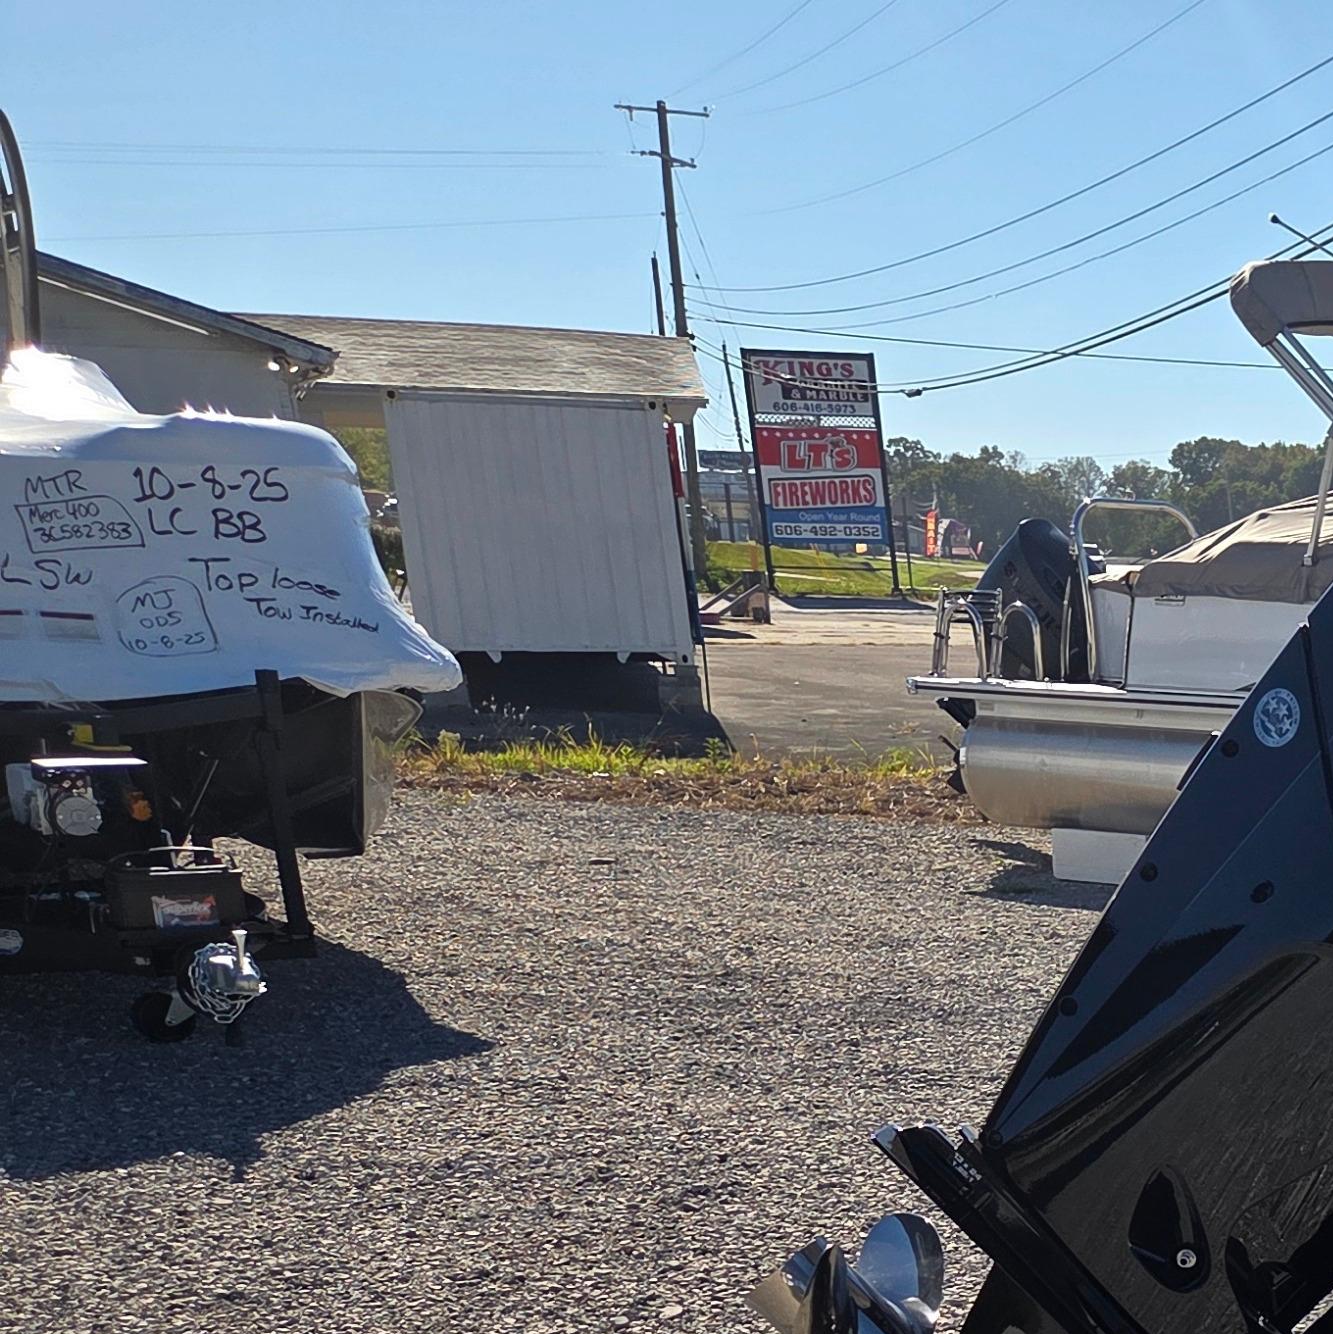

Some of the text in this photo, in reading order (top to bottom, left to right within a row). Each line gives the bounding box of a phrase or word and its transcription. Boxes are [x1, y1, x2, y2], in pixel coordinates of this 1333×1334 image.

[25, 469, 88, 503] MTR
[132, 465, 290, 502] 10-8-25
[772, 478, 874, 508] FIREWORKS
[66, 502, 100, 521] 400
[211, 507, 267, 544] BB
[774, 525, 880, 538] 606-492-0352
[187, 556, 259, 593] Top
[242, 596, 293, 621] Tow
